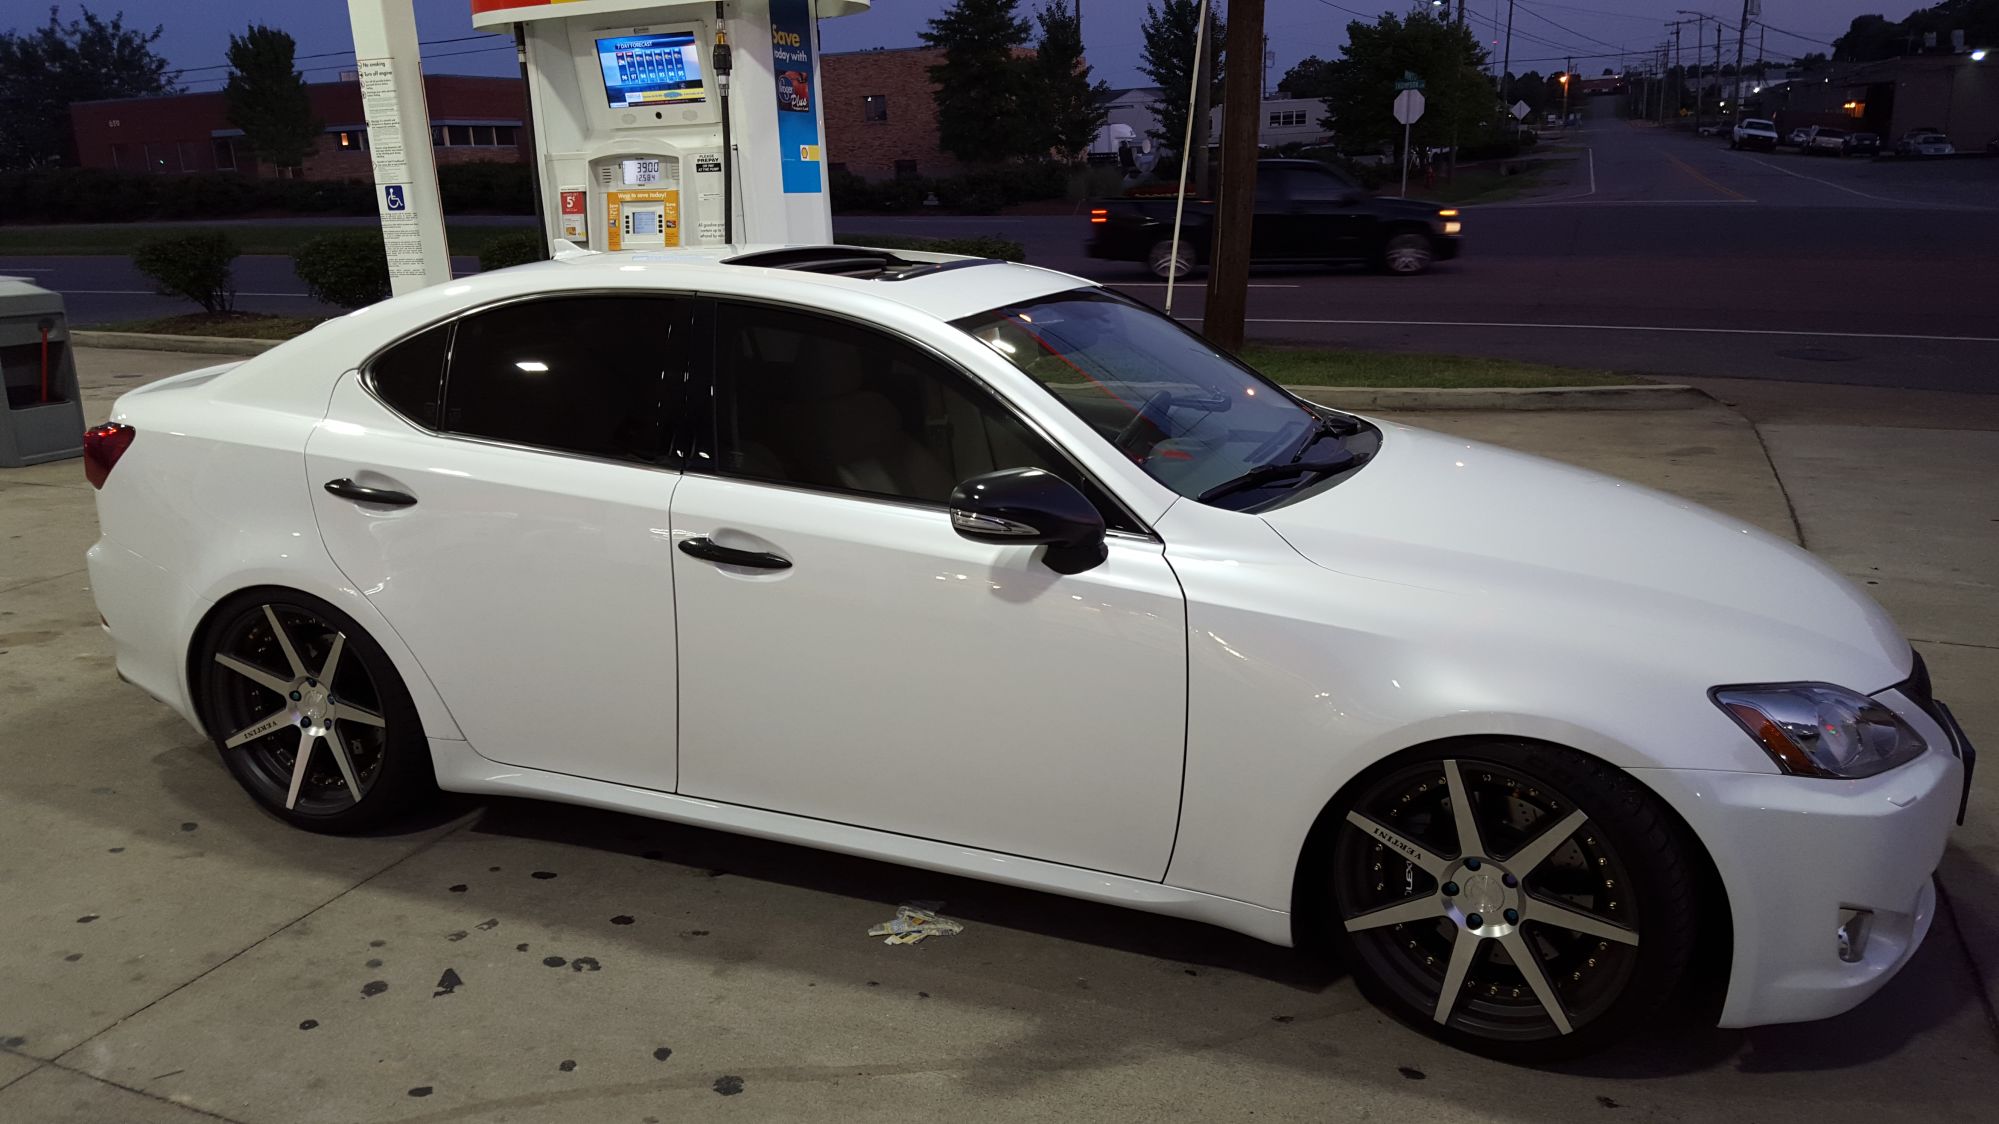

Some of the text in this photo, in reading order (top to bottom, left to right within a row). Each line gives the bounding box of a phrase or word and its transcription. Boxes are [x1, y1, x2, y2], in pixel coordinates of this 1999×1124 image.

[772, 24, 800, 47] Save
[790, 50, 808, 62] with
[791, 94, 808, 108] Plus
[649, 191, 667, 200] today!
[244, 720, 278, 739] VERTINI
[1373, 827, 1422, 860] VERTINI
[1405, 860, 1413, 890] LEX
